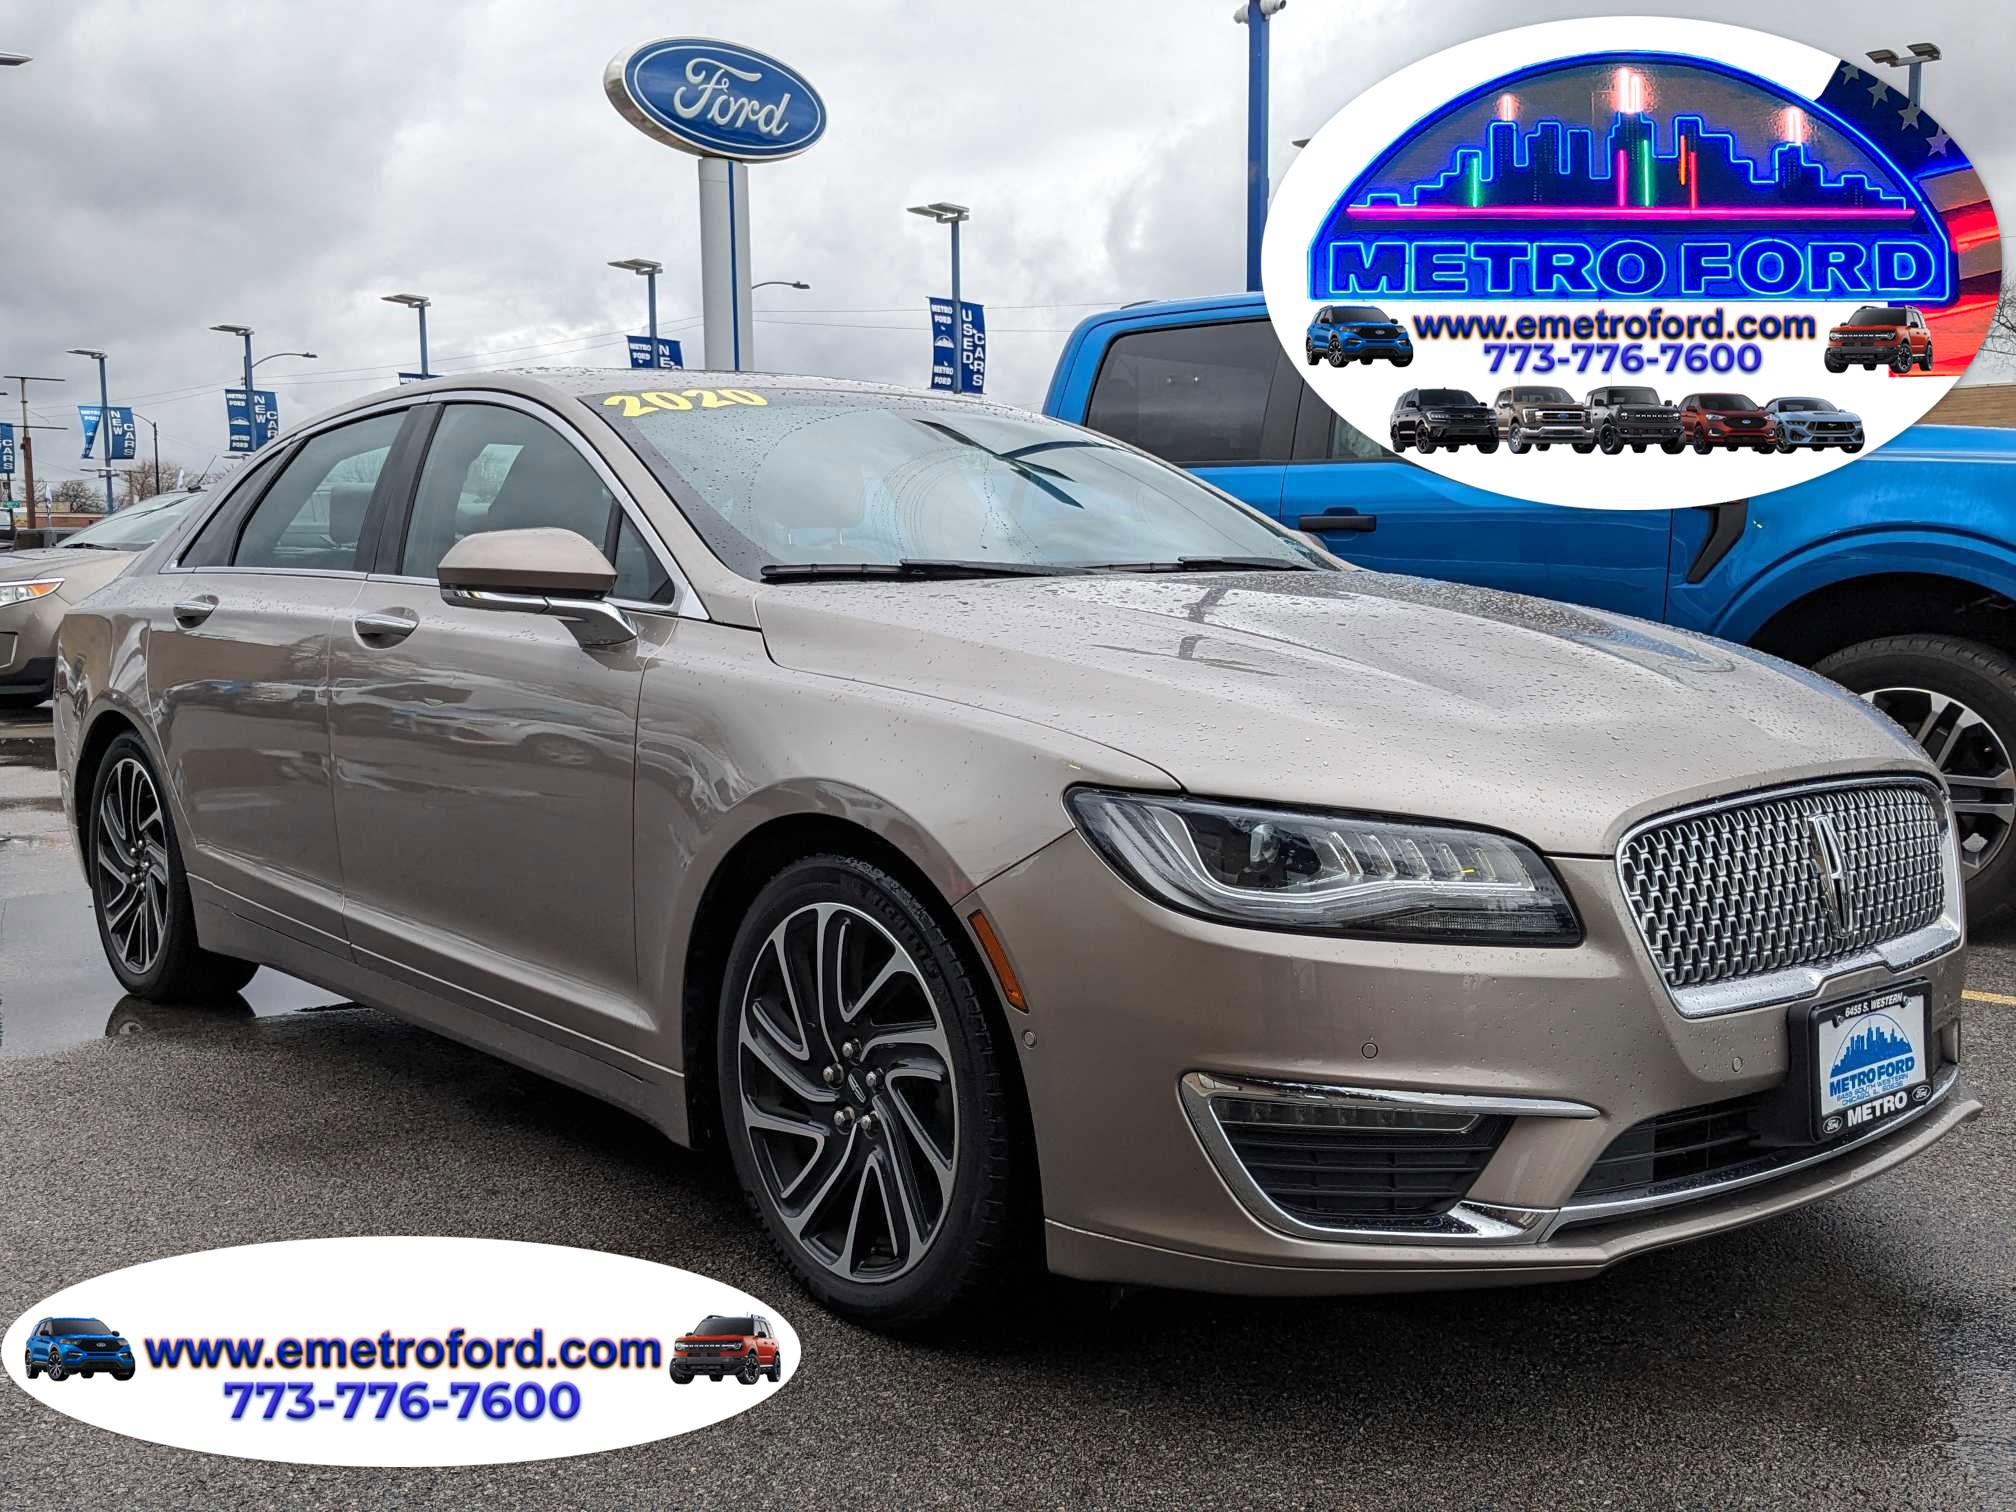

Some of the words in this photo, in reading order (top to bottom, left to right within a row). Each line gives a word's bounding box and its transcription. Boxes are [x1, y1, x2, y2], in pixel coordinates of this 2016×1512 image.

[674, 57, 791, 136] Ford
[962, 308, 973, 364] USED
[972, 333, 985, 386] CARS
[254, 395, 266, 424] NEW
[603, 388, 769, 417] 2020
[110, 410, 122, 435] NEW
[267, 411, 278, 439] CAR
[2, 439, 13, 470] CARS
[123, 423, 135, 456] CARS
[1870, 992, 1903, 1010] WESTERN
[1829, 1068, 1876, 1098] METRO
[1877, 1055, 1915, 1080] FORD
[1847, 1091, 1908, 1127] METRO
